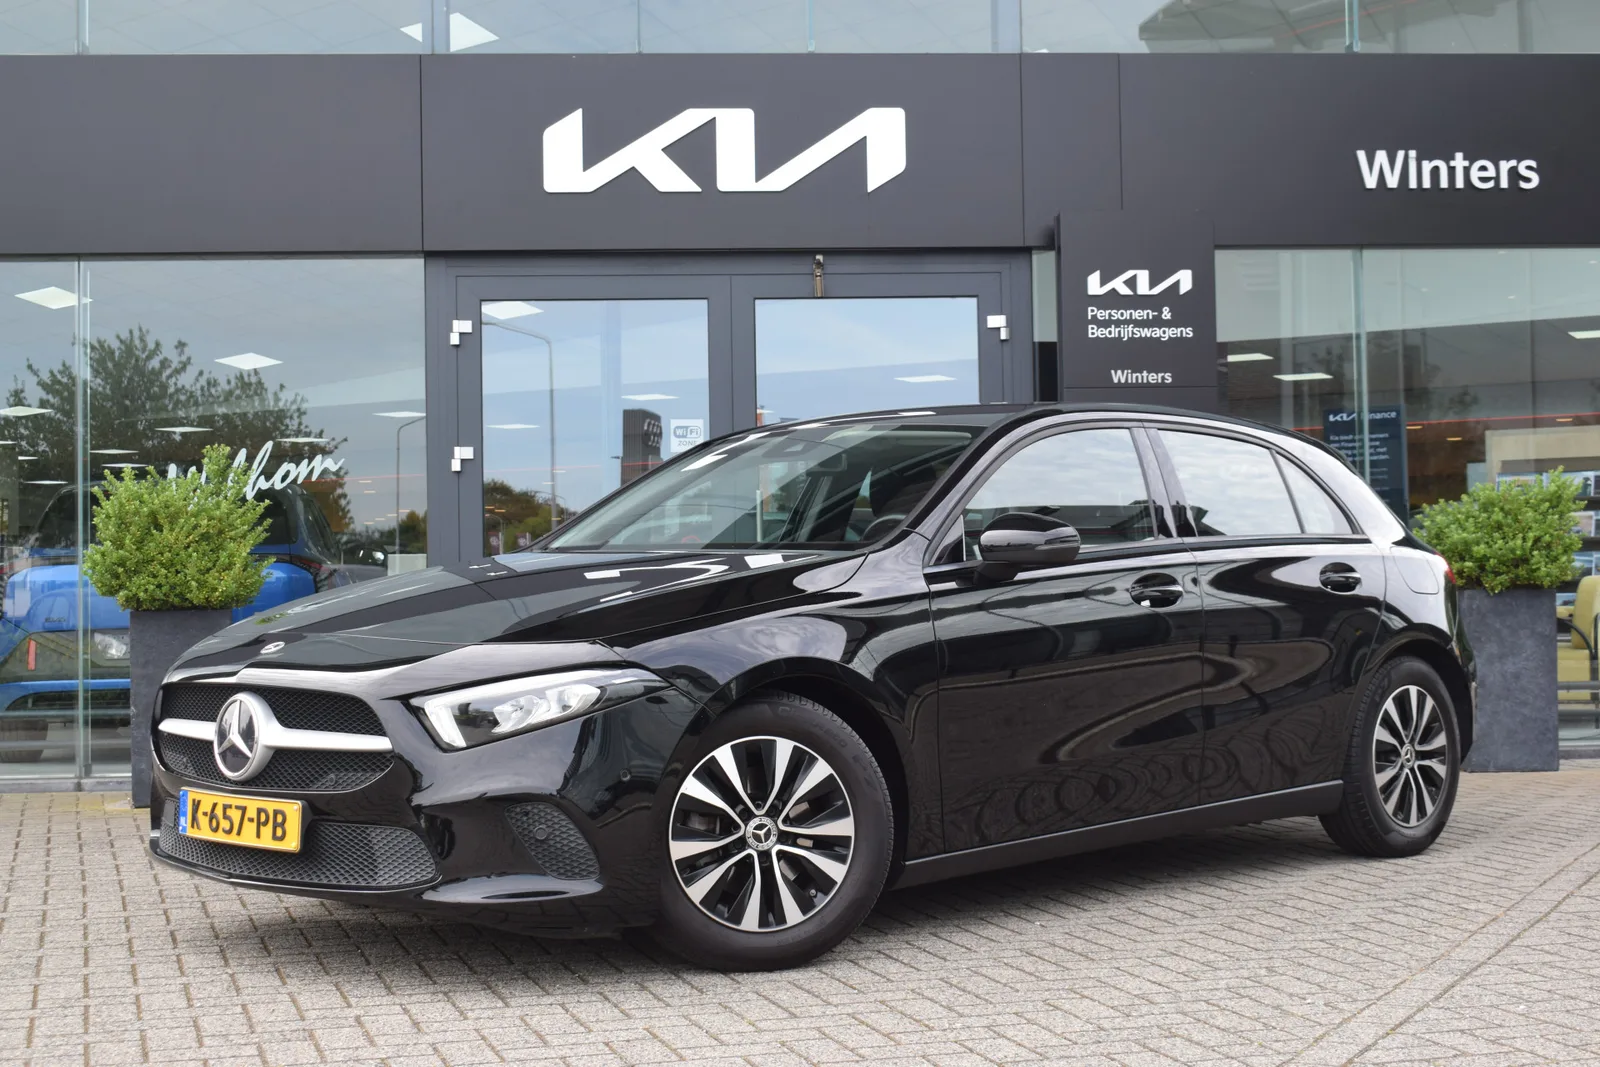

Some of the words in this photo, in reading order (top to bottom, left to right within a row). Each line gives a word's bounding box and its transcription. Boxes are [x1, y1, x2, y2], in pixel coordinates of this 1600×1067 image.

[543, 107, 906, 193] KIA
[1356, 149, 1540, 190] Winters
[1087, 269, 1193, 296] KIA
[1087, 306, 1159, 320] Personen-
[1161, 306, 1172, 320] &
[1087, 324, 1194, 341] Bedrijfswagens
[1110, 369, 1173, 384] Winters
[190, 798, 287, 842] K-657-PB
